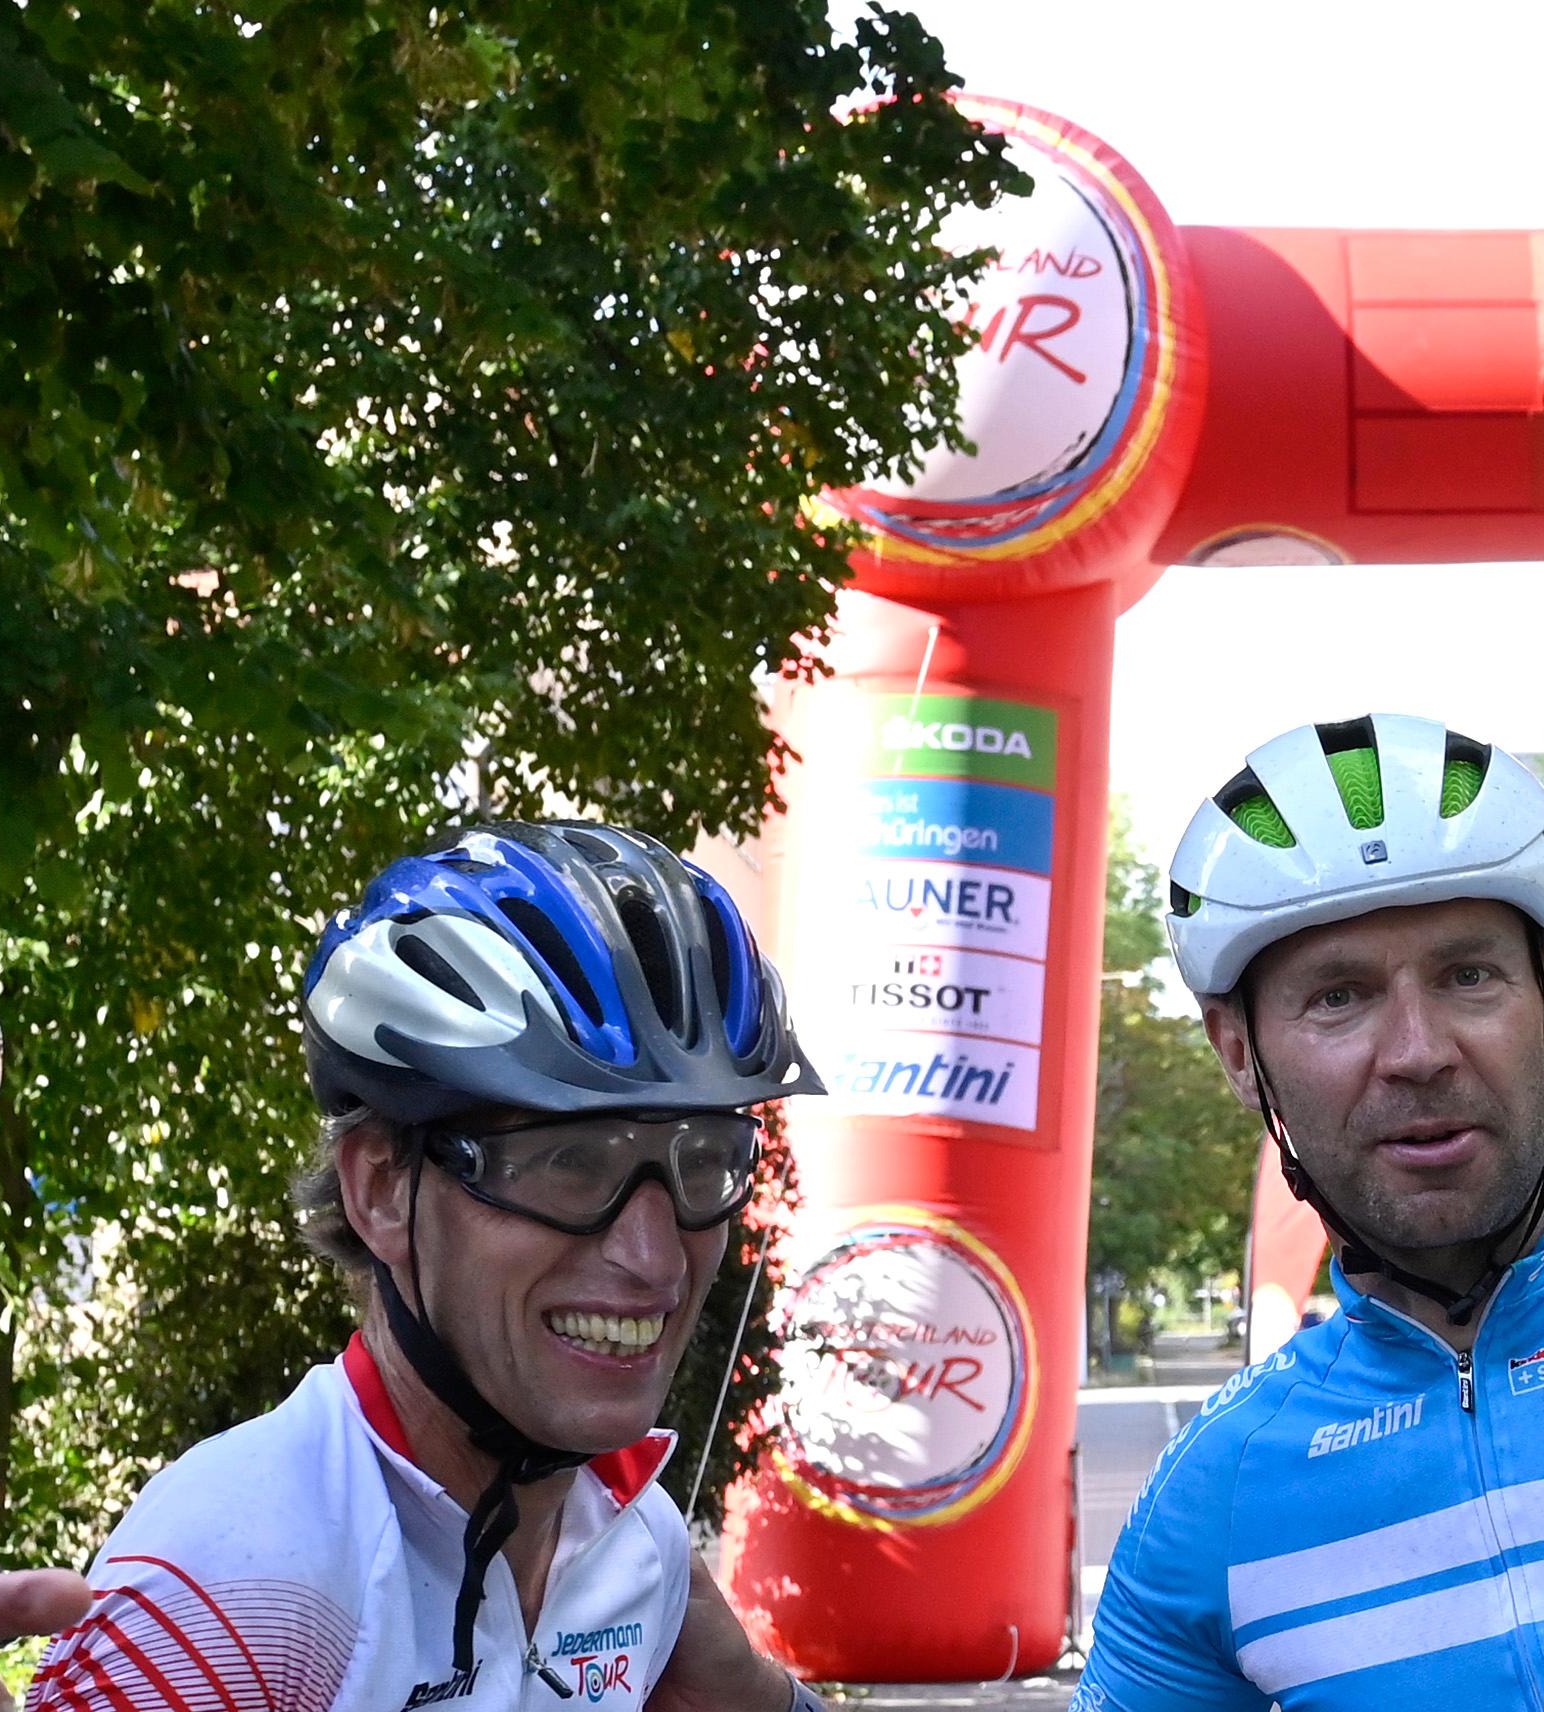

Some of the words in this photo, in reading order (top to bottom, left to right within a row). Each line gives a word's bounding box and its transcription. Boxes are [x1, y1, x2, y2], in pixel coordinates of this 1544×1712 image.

[856, 879, 1016, 924] AUNER
[851, 983, 991, 1014] TISSOT
[1307, 1393, 1426, 1460] Santini
